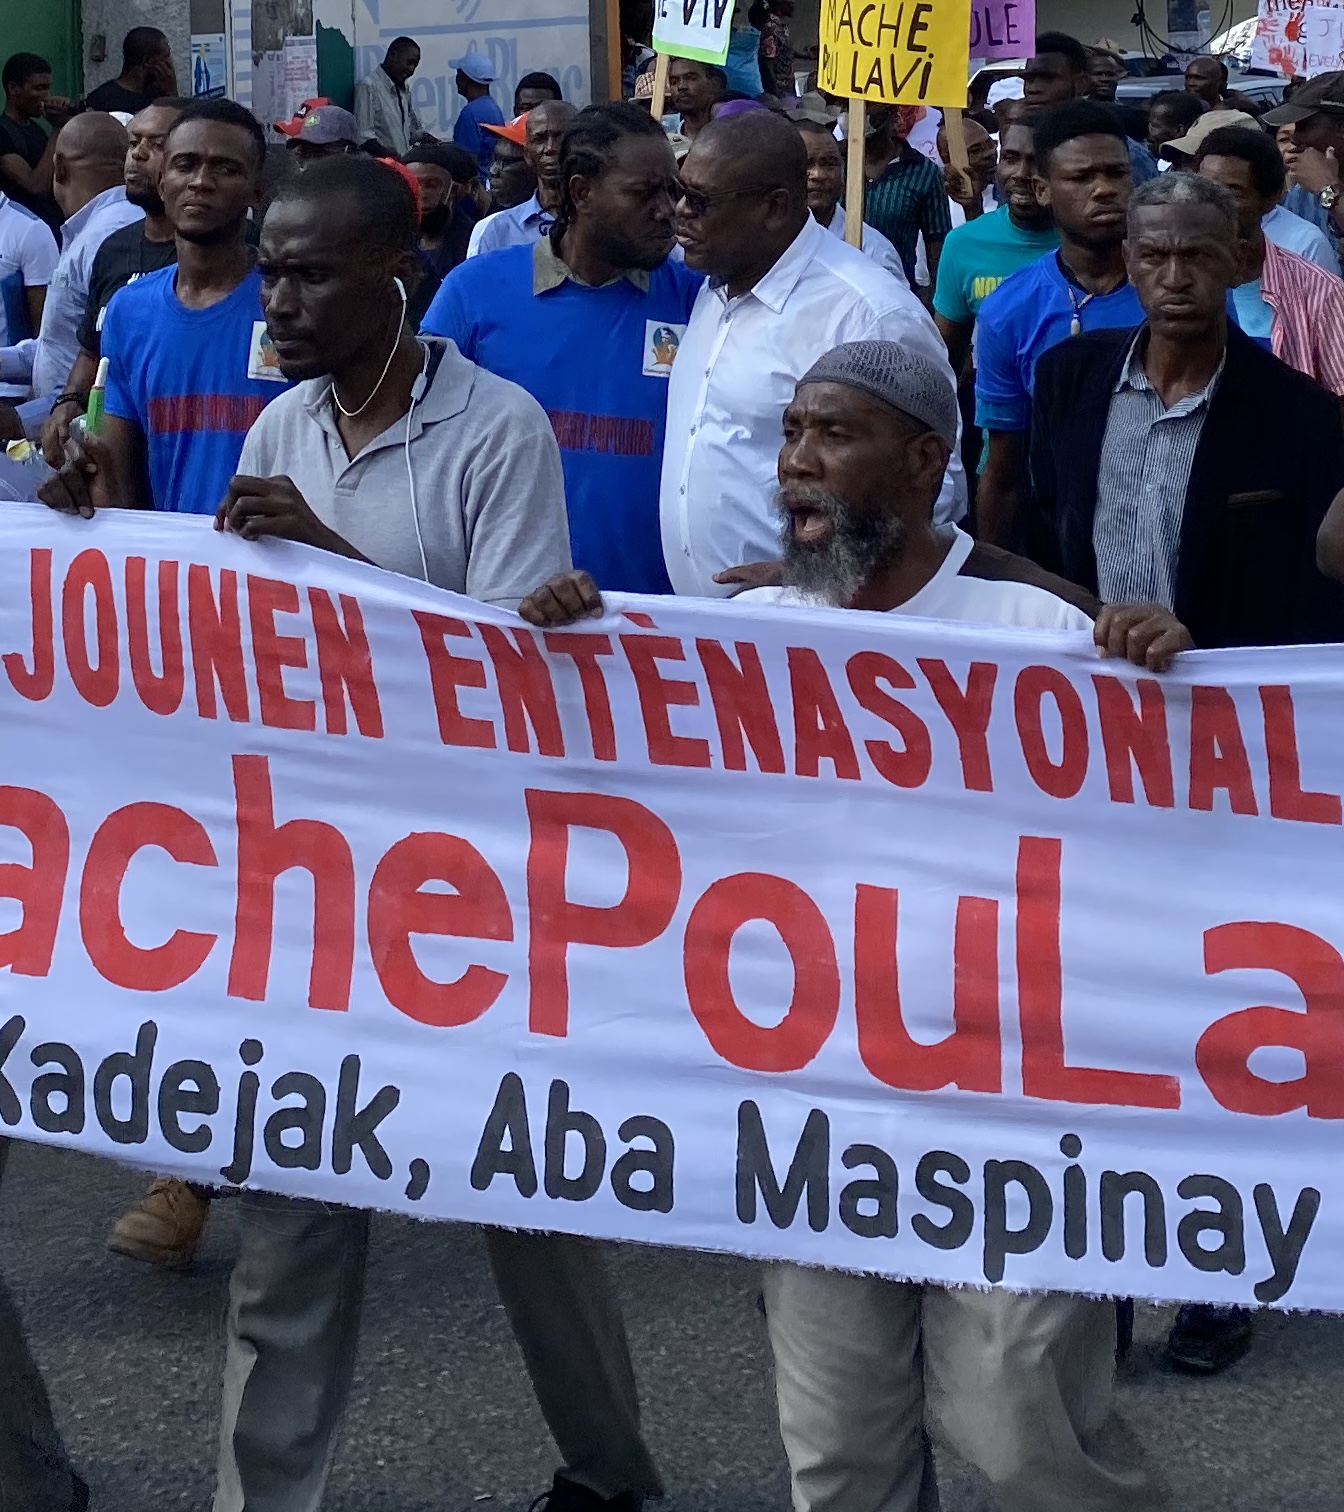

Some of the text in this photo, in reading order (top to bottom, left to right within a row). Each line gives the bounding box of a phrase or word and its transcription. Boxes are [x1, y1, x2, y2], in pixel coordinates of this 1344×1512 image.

[1, 547, 385, 739] JOUNEN
[411, 607, 1343, 826] ENTÈNASYONAL
[469, 1071, 674, 1215] Aba
[736, 1099, 1321, 1304] Maspinay
